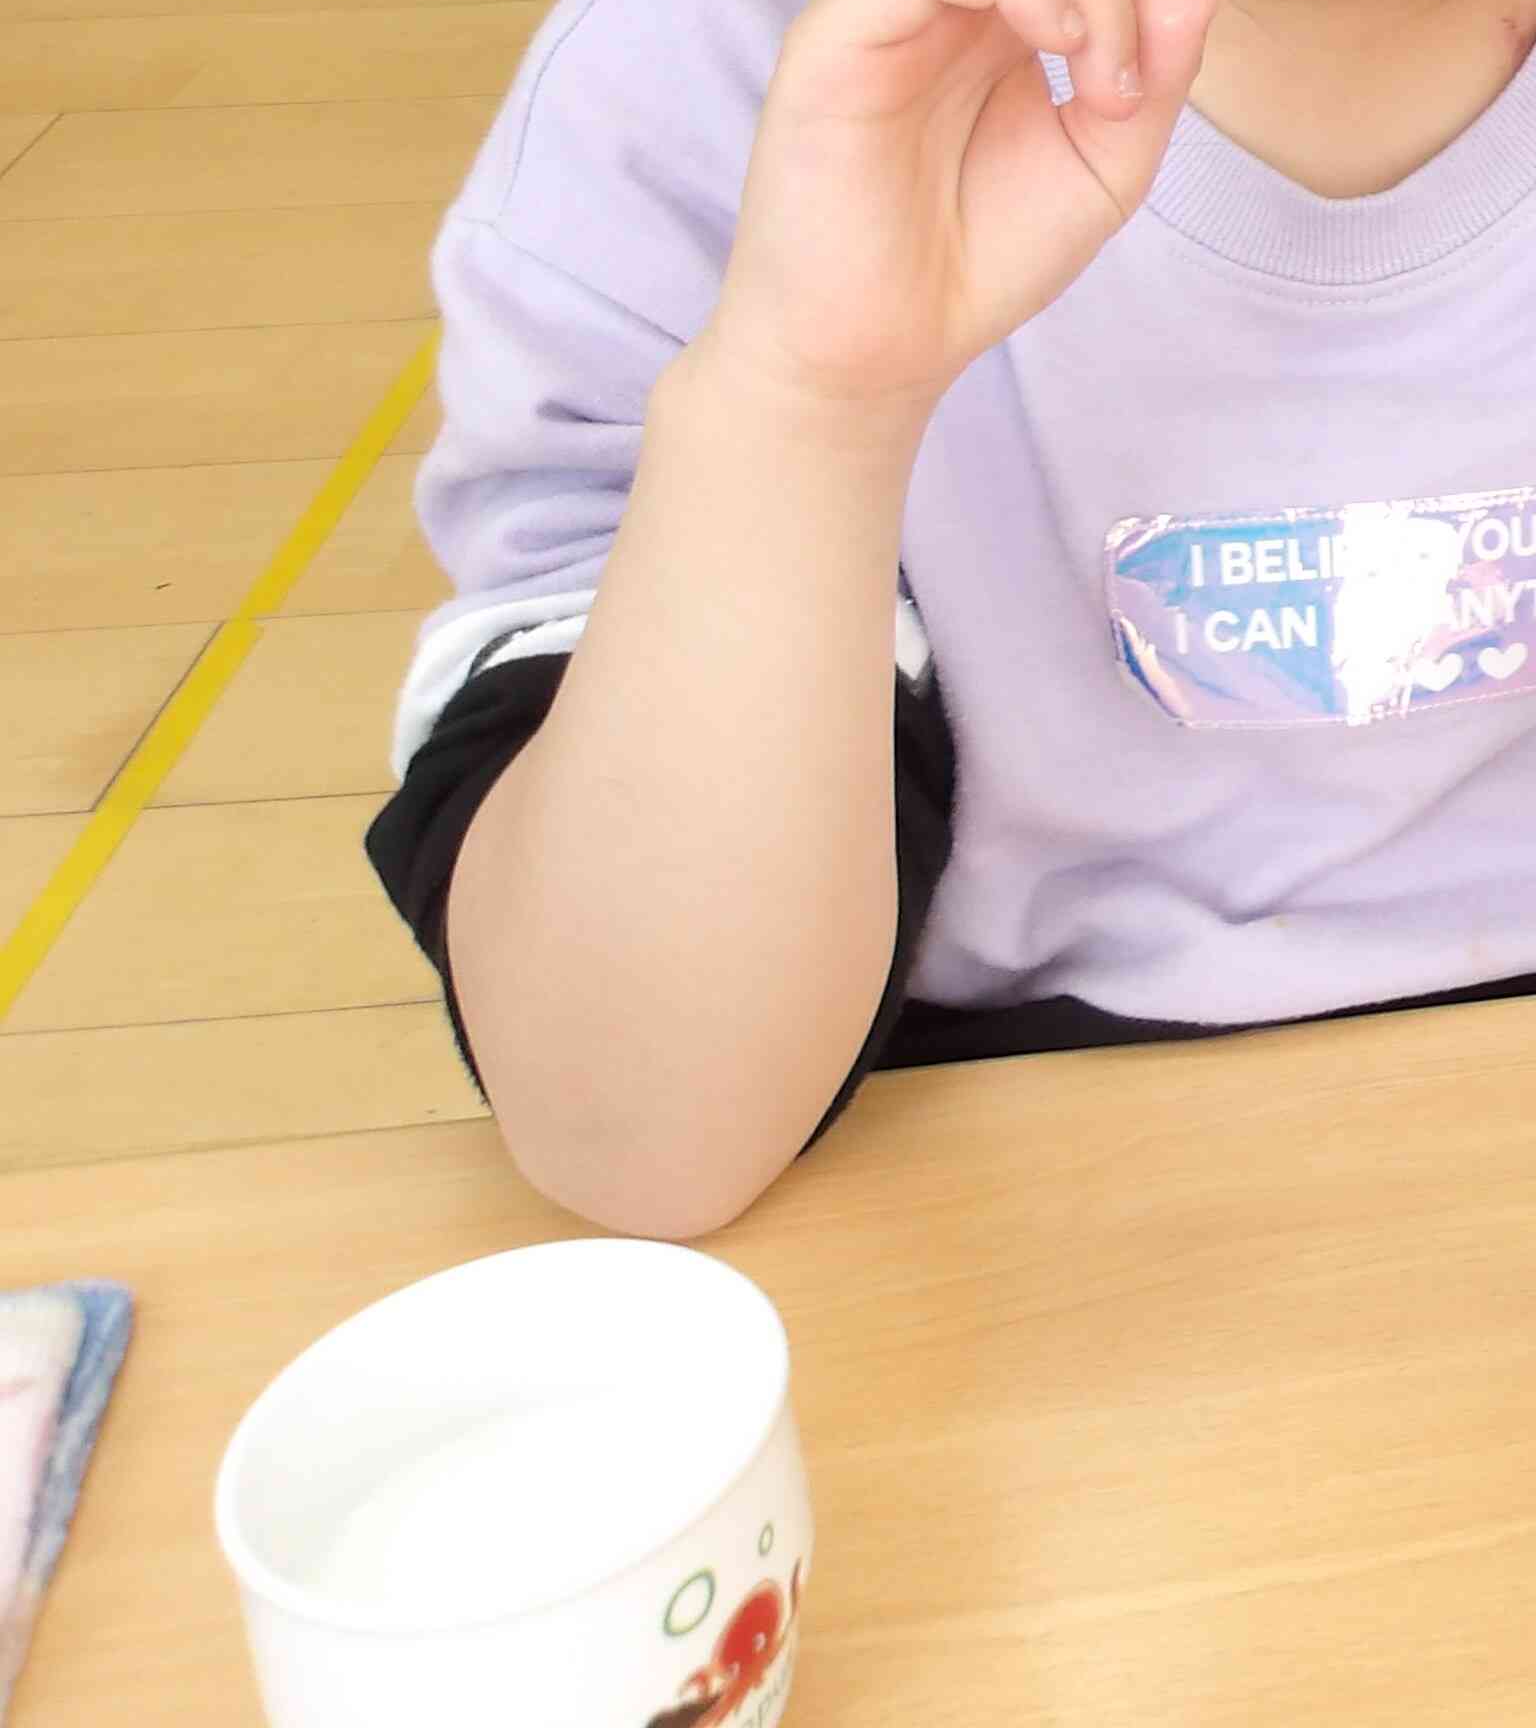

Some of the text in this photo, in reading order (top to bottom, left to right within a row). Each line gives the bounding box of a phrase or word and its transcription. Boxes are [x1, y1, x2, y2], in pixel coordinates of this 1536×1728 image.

[1191, 543, 1205, 588] I
[1175, 611, 1189, 655] I
[1204, 604, 1318, 652] CAN
